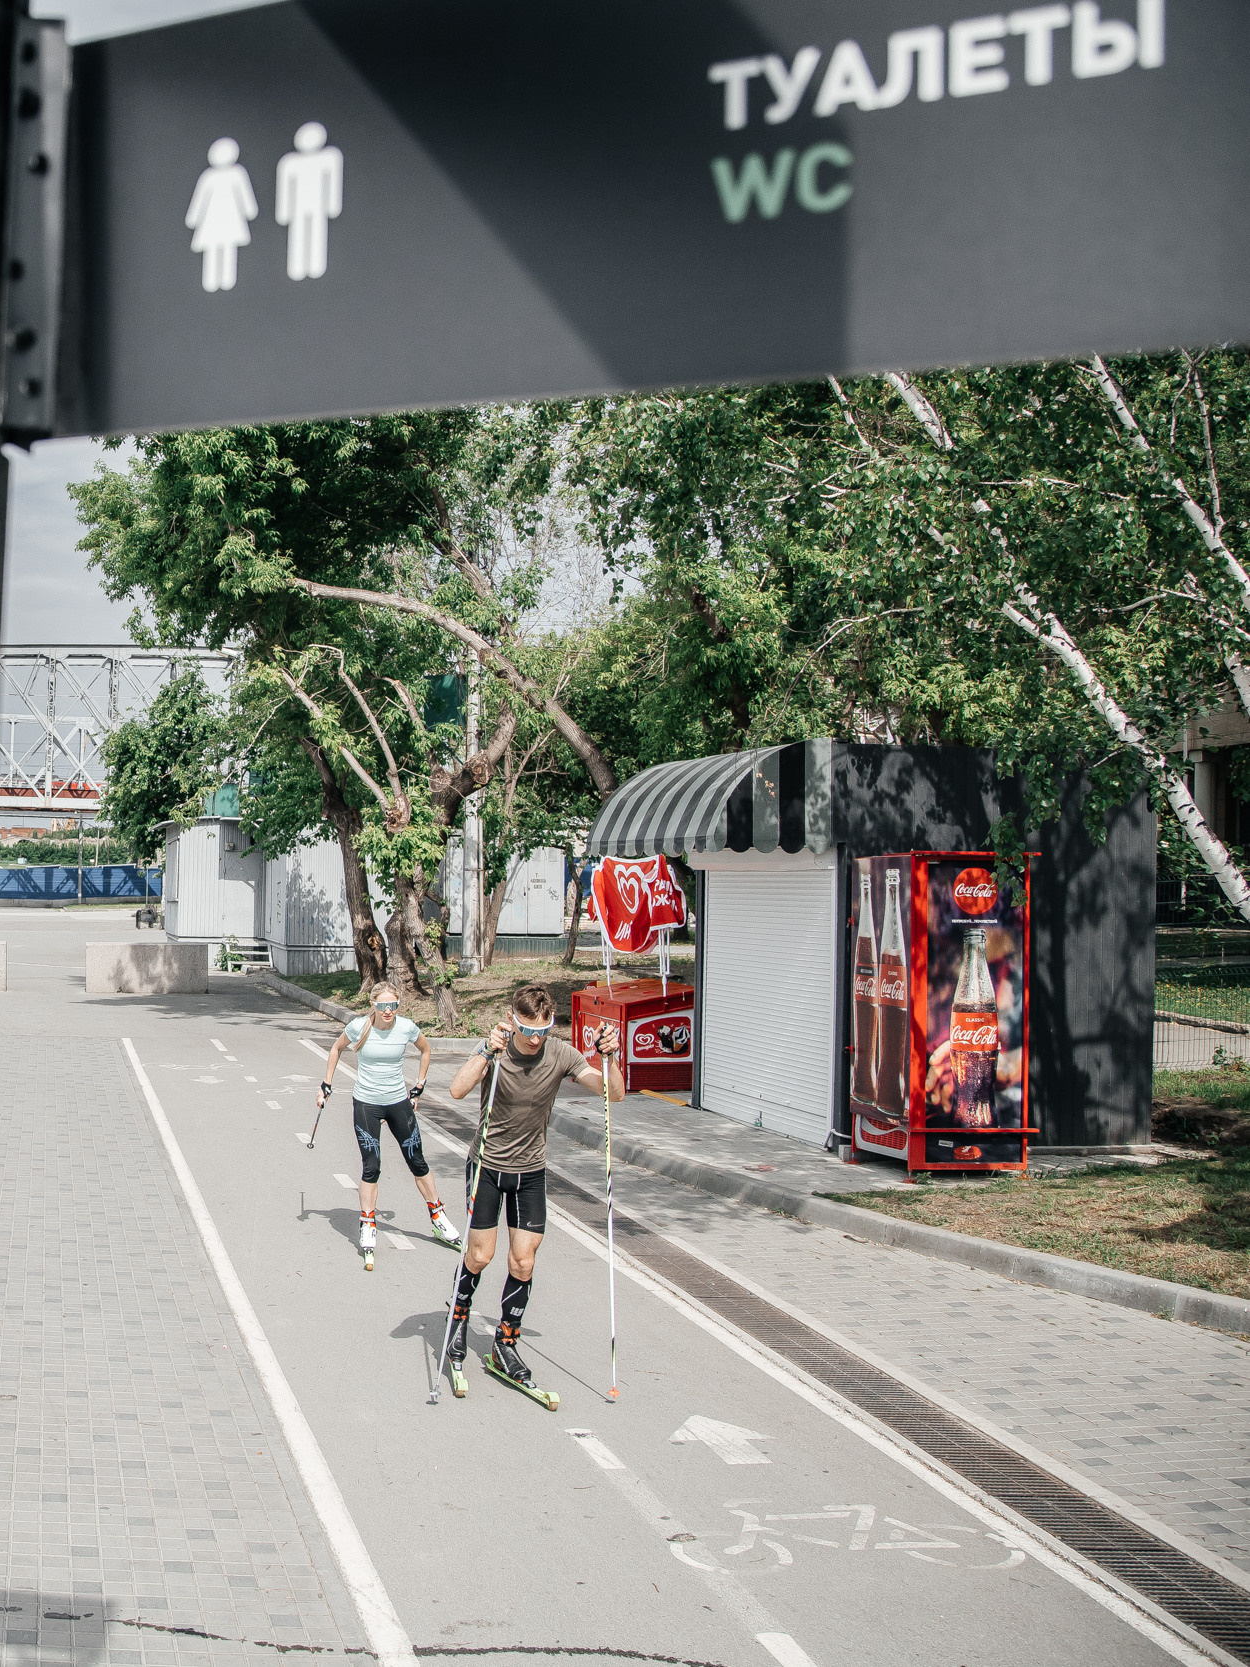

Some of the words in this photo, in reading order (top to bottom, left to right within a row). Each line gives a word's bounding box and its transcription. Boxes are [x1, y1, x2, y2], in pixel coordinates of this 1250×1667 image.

[707, 0, 1167, 131] ТУАЛЕТЫ
[711, 142, 853, 224] WC
[950, 1025, 998, 1045] Coca-Cola
